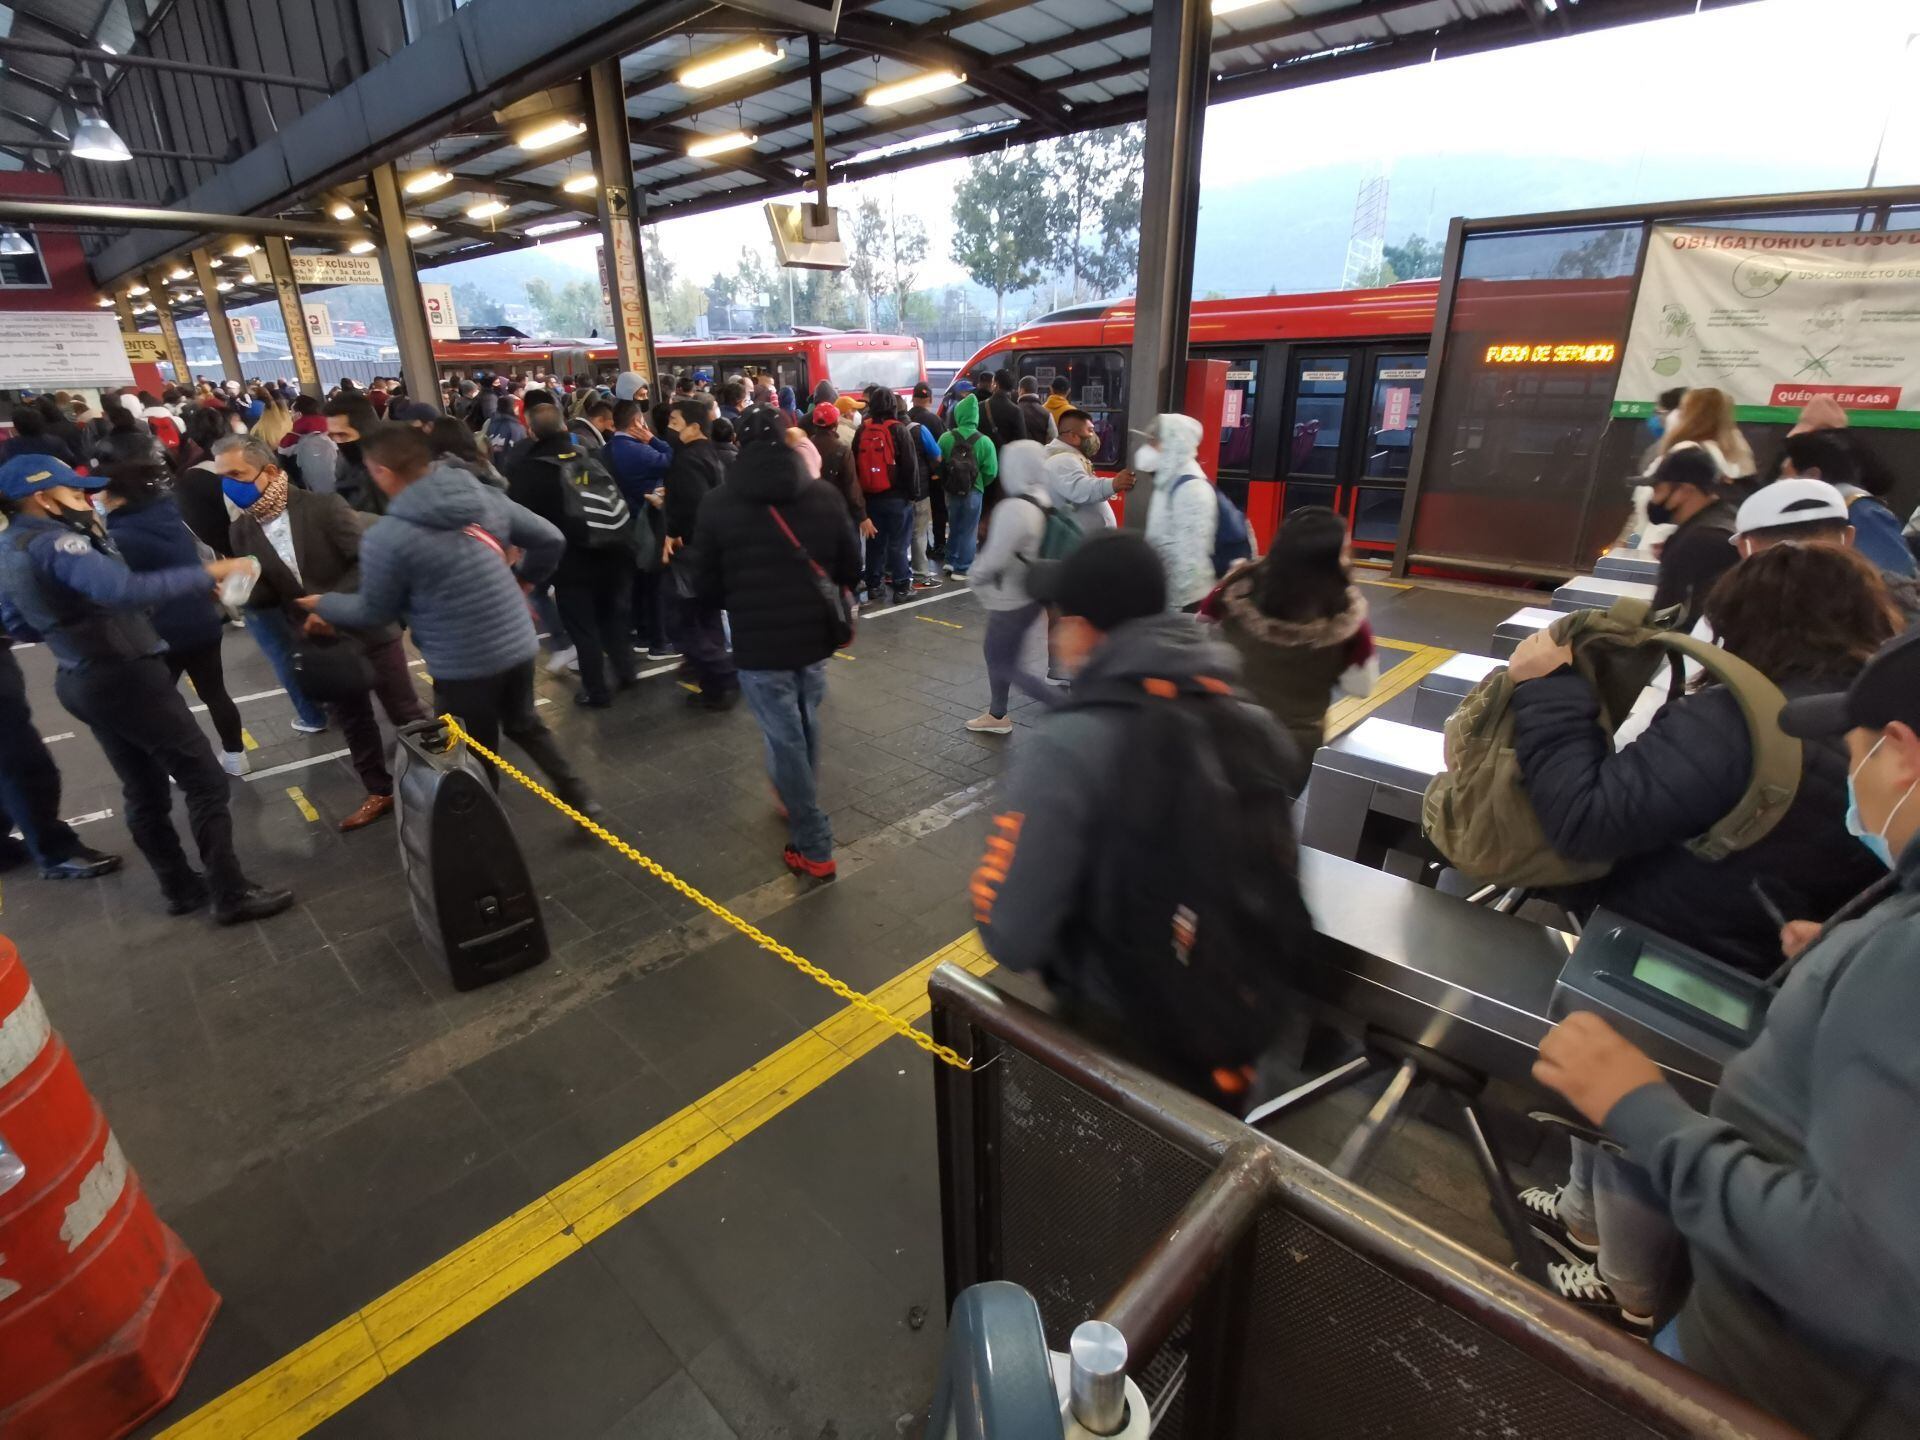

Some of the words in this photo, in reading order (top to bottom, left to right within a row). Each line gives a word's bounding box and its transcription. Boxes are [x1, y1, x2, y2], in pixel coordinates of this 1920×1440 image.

[316, 257, 369, 269] Exclusivo
[1829, 270, 1895, 280] CORRECTO
[615, 222, 648, 373] INSURGENTE
[123, 340, 157, 349] ENTES
[1486, 346, 1529, 362] FUERA
[1531, 346, 1551, 361] DE
[1553, 345, 1615, 361] SERVICIO
[1837, 394, 1855, 402] EN
[1857, 394, 1890, 404] CASA
